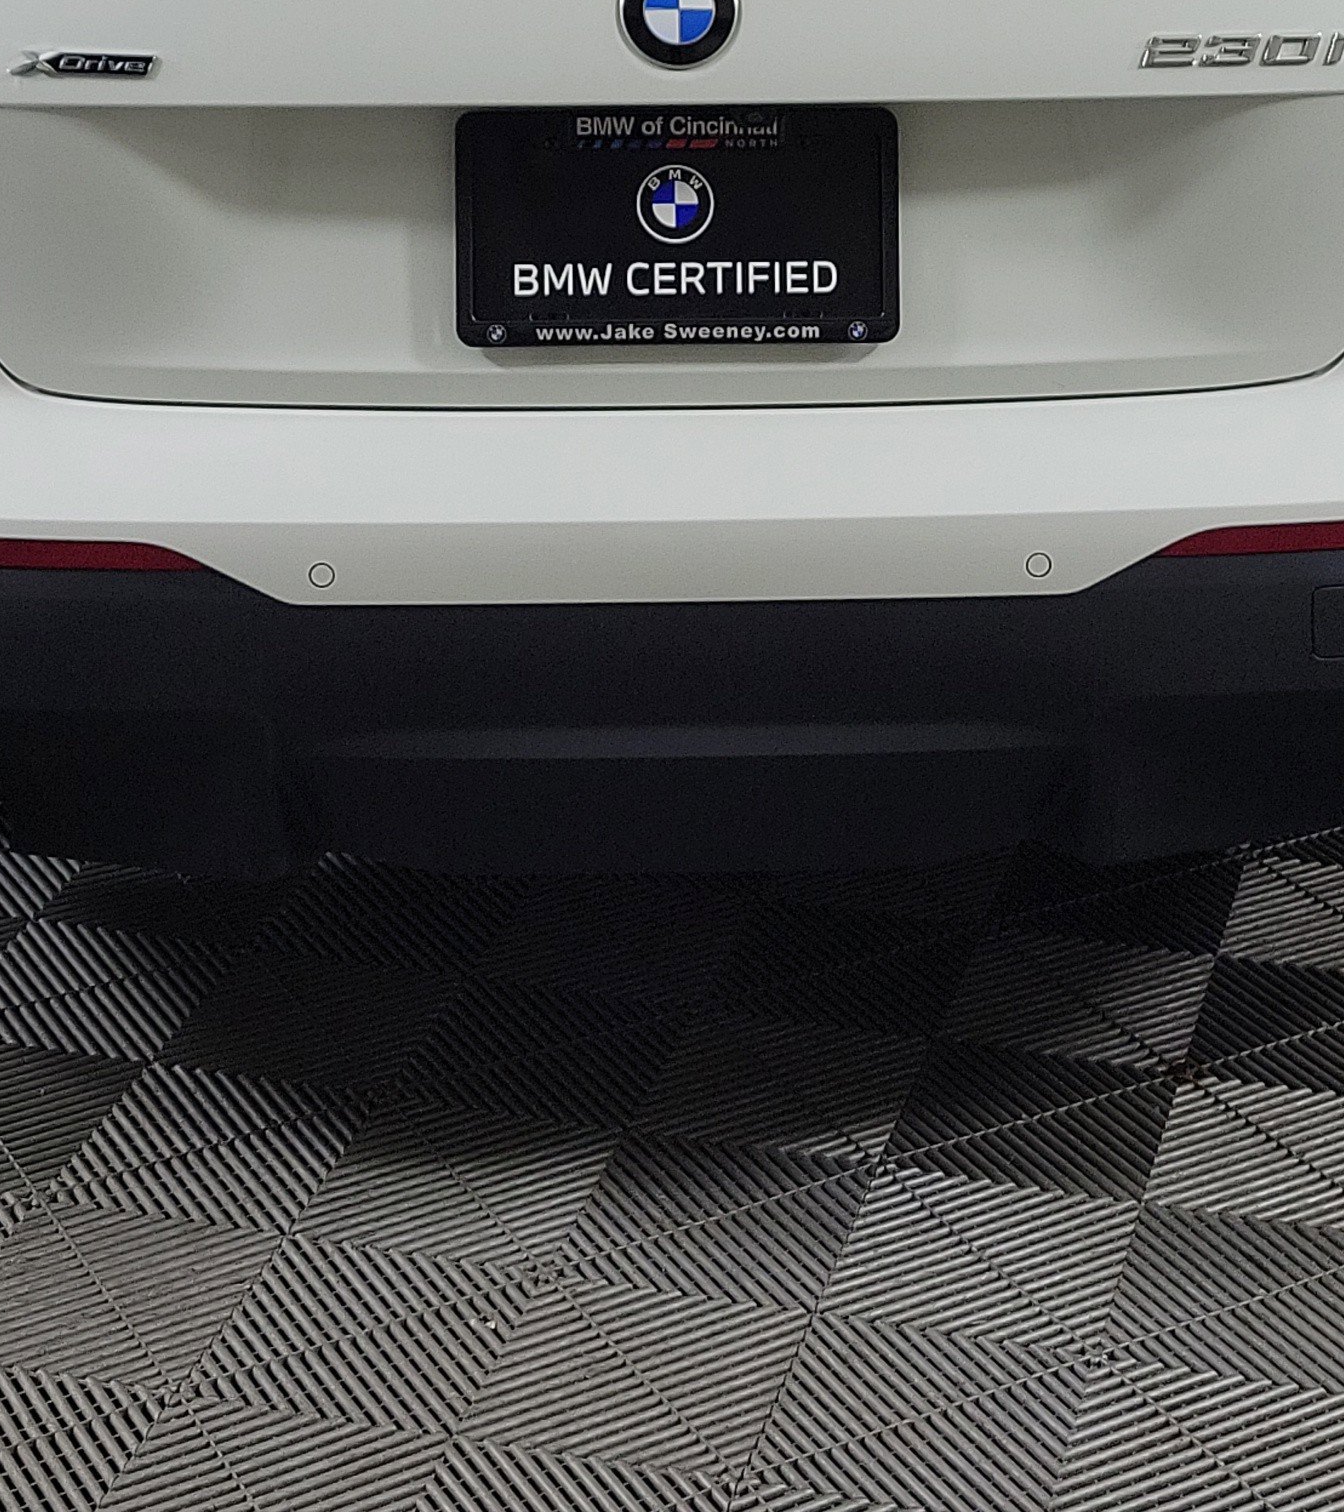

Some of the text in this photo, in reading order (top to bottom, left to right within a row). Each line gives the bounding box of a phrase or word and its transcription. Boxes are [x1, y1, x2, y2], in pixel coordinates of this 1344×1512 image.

[576, 116, 635, 136] BMW
[641, 116, 664, 136] of
[723, 139, 779, 148] NORTH
[647, 169, 704, 191] BMW
[513, 260, 839, 298] BMW CERTIFIED
[536, 323, 821, 342] www.Jake Sweeney.com
